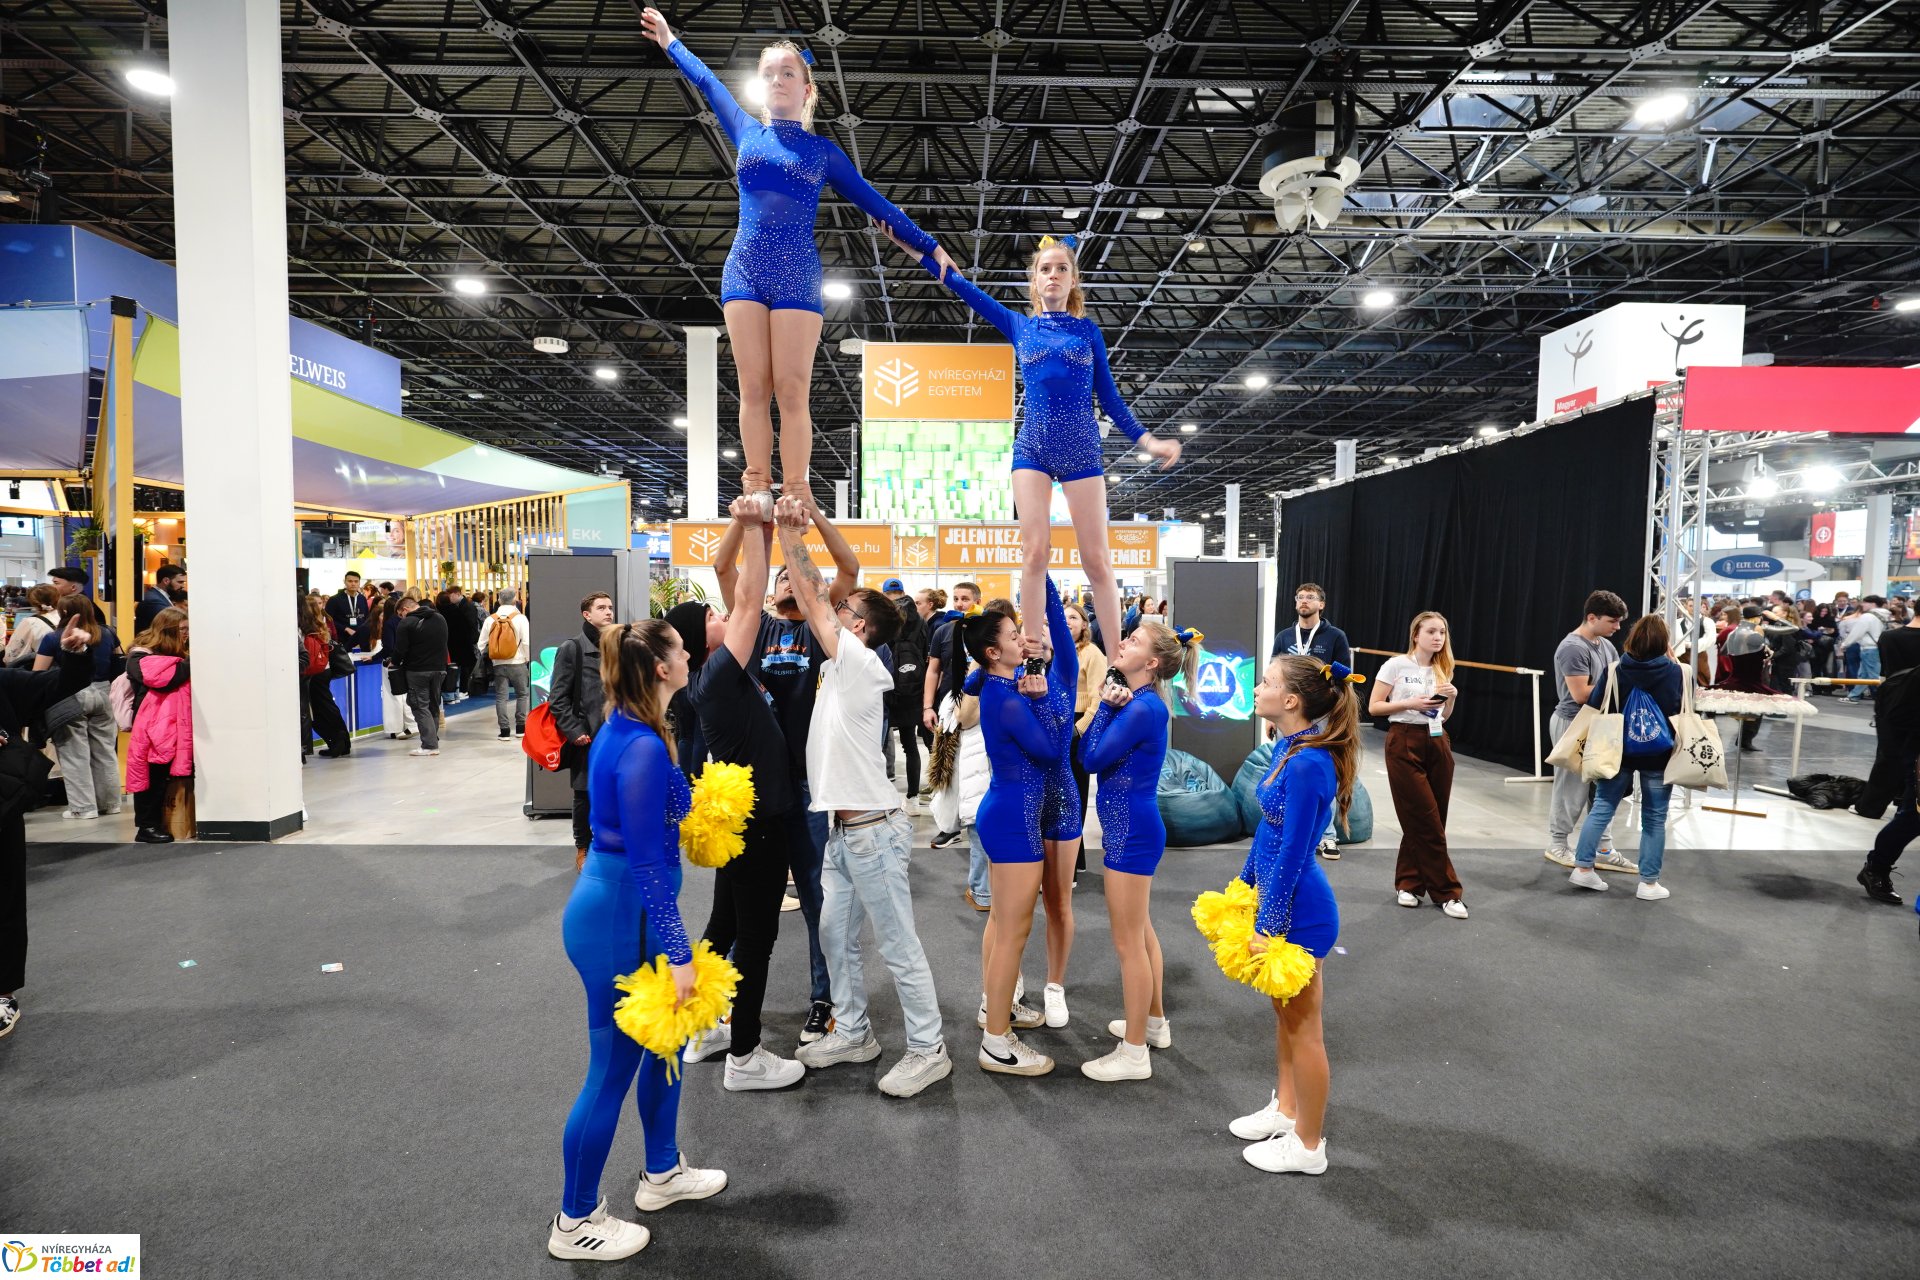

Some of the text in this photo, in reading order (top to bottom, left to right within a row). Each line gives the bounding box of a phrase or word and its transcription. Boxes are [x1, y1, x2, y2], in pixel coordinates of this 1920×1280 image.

[290, 354, 346, 389] ELWEIS
[928, 368, 1006, 381] NYÍREGYHÁZI
[928, 385, 982, 396] EGYETEM
[571, 528, 602, 541] EKK
[944, 527, 1023, 546] JELENTKEZ
[960, 546, 1151, 565] A NYÍREGZI EEMRE!
[1199, 663, 1227, 687] AI
